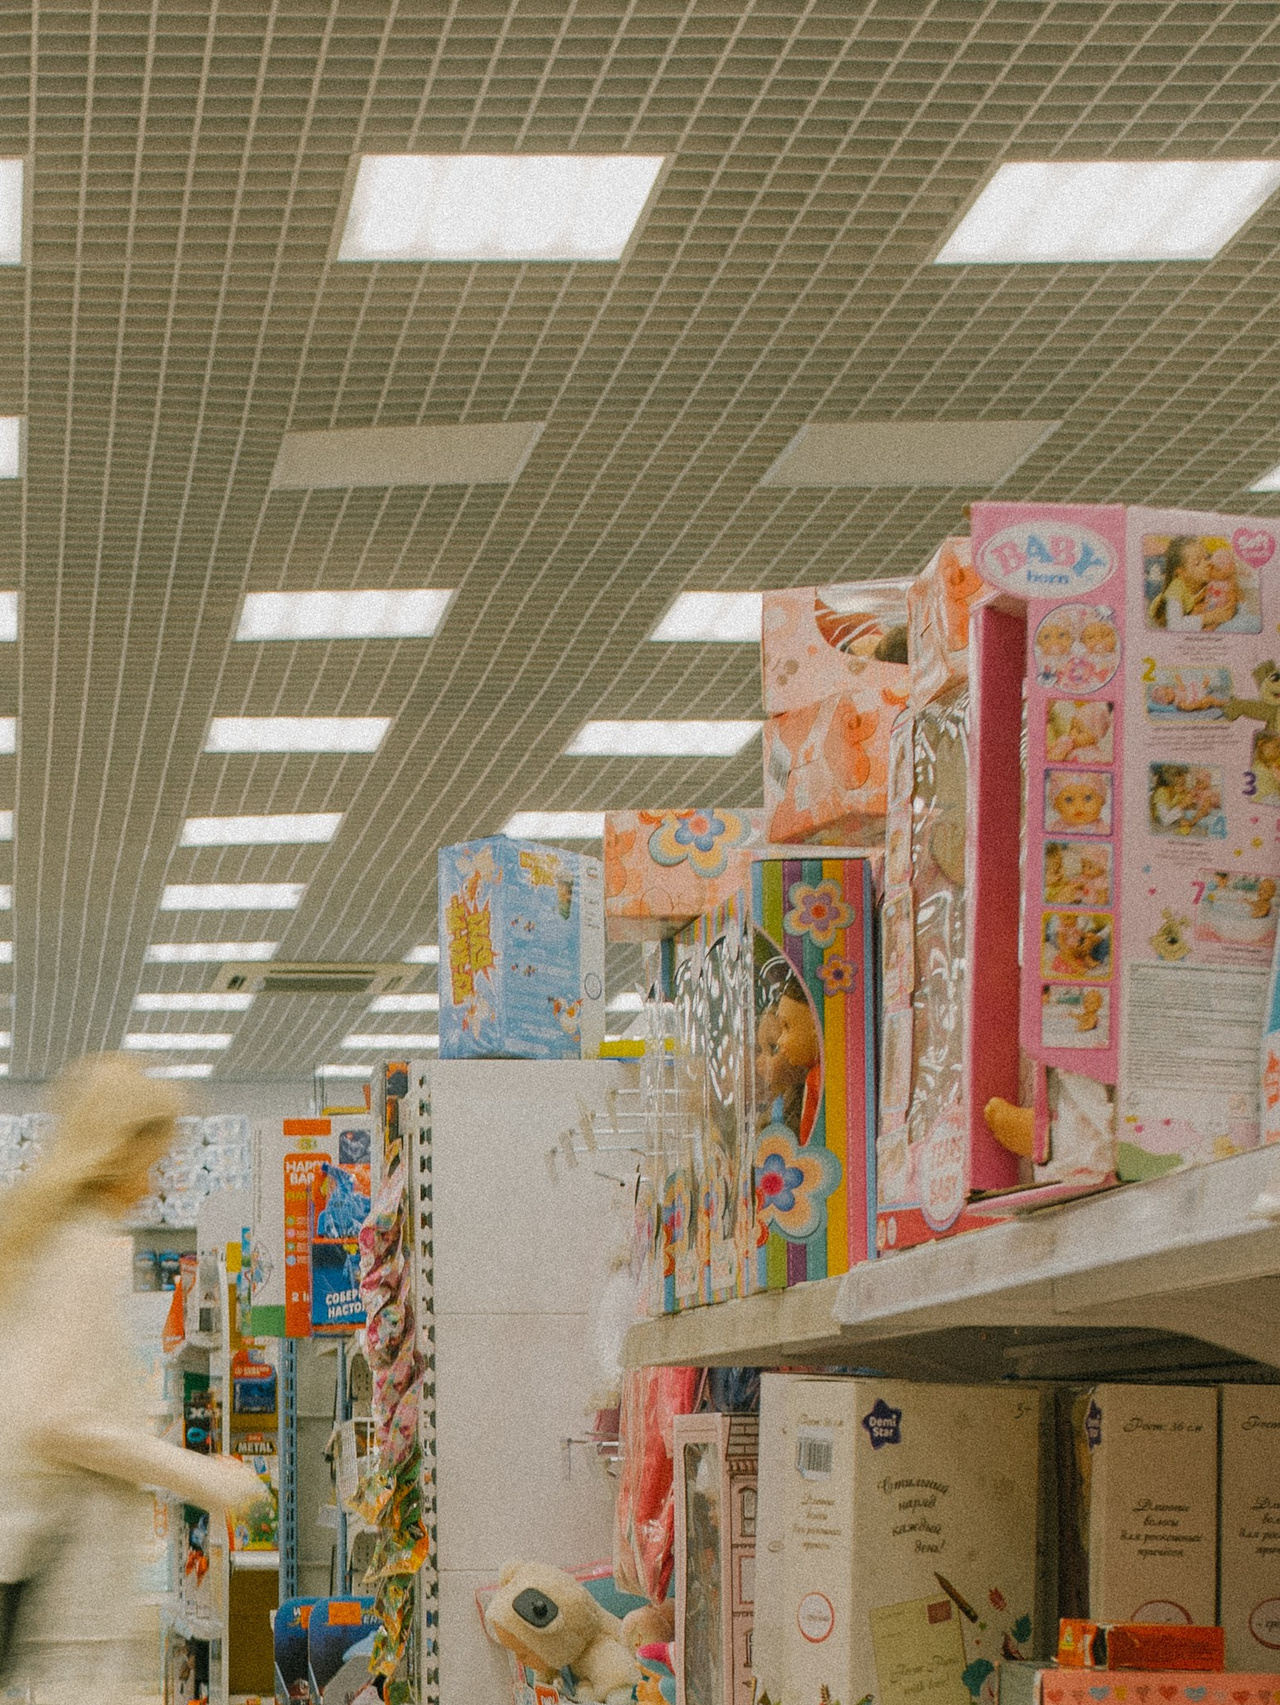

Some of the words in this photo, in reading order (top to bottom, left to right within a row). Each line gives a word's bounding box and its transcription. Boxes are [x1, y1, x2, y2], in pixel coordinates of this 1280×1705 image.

[990, 534, 1105, 577] BABY
[1026, 570, 1070, 583] born
[1141, 658, 1156, 682] 2
[1242, 772, 1257, 797] 3
[1191, 881, 1205, 905] 7
[870, 1415, 897, 1428] Demi
[873, 1427, 894, 1438] Star
[237, 1442, 274, 1453] METAL
